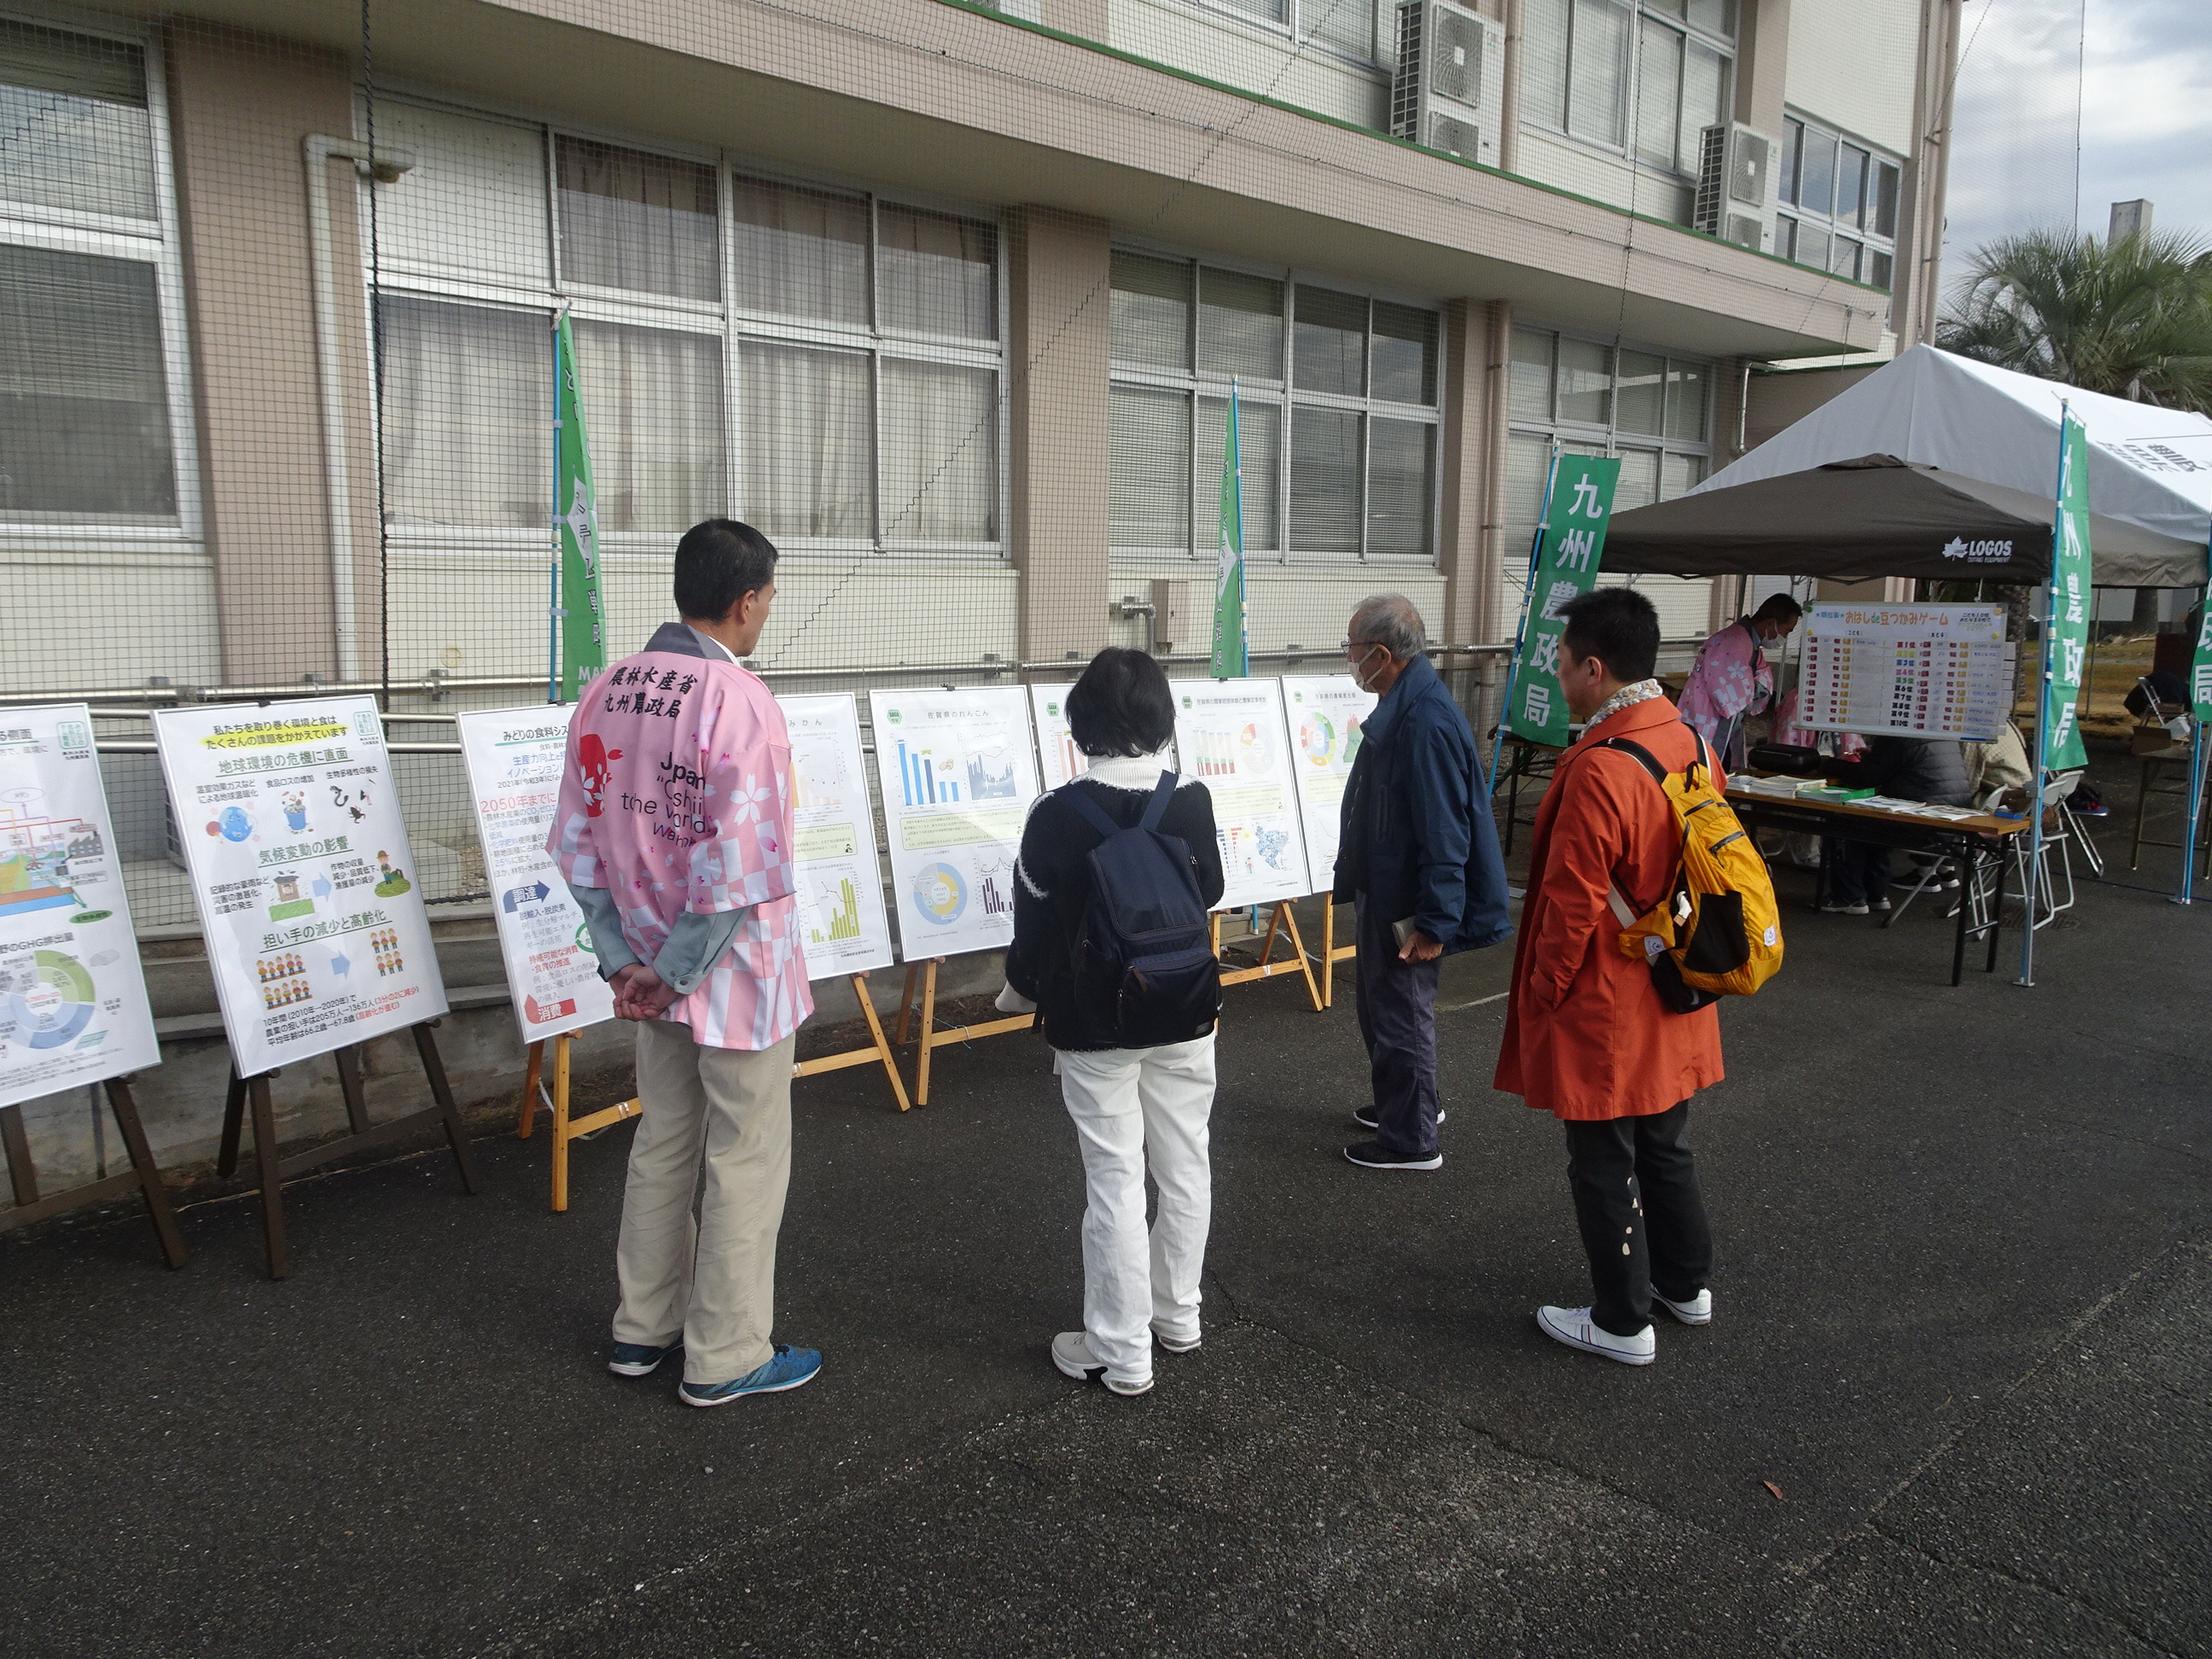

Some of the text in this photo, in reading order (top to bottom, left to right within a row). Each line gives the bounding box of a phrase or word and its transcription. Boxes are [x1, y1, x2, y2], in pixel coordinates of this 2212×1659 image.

[1969, 540, 2012, 556] LOGOS
[1523, 473, 1603, 727] 九州農政局
[608, 666, 698, 695] 農林水産省
[604, 691, 682, 719] 九州農政局
[928, 709, 989, 719] 佐賀県のれんこん
[213, 715, 337, 735] 私たちを取り巻く環境と食は
[504, 725, 568, 742] みどりの食料シス
[206, 727, 347, 750] たくさんの課題をかかえています
[218, 748, 348, 774] 地球環境の危機に直面
[326, 766, 379, 779] 生物多様性の損失
[195, 778, 256, 795] 温室効果ガスなど
[266, 775, 315, 789] 食品ロスの増加
[199, 789, 259, 804] による地球温暖化
[480, 793, 556, 813] 2050年までに
[259, 835, 349, 864] 気候変動の影響
[331, 858, 364, 870] 作物の収量
[210, 876, 270, 894] 記録的な豪雨など
[512, 886, 538, 903] 調達
[214, 900, 253, 915] 高温の発生
[263, 909, 387, 950] 担い手の減少と高齢化
[524, 923, 573, 940] 再生可能エネル
[529, 945, 579, 964] 持続可能な消費
[538, 1003, 562, 1022] 消費
